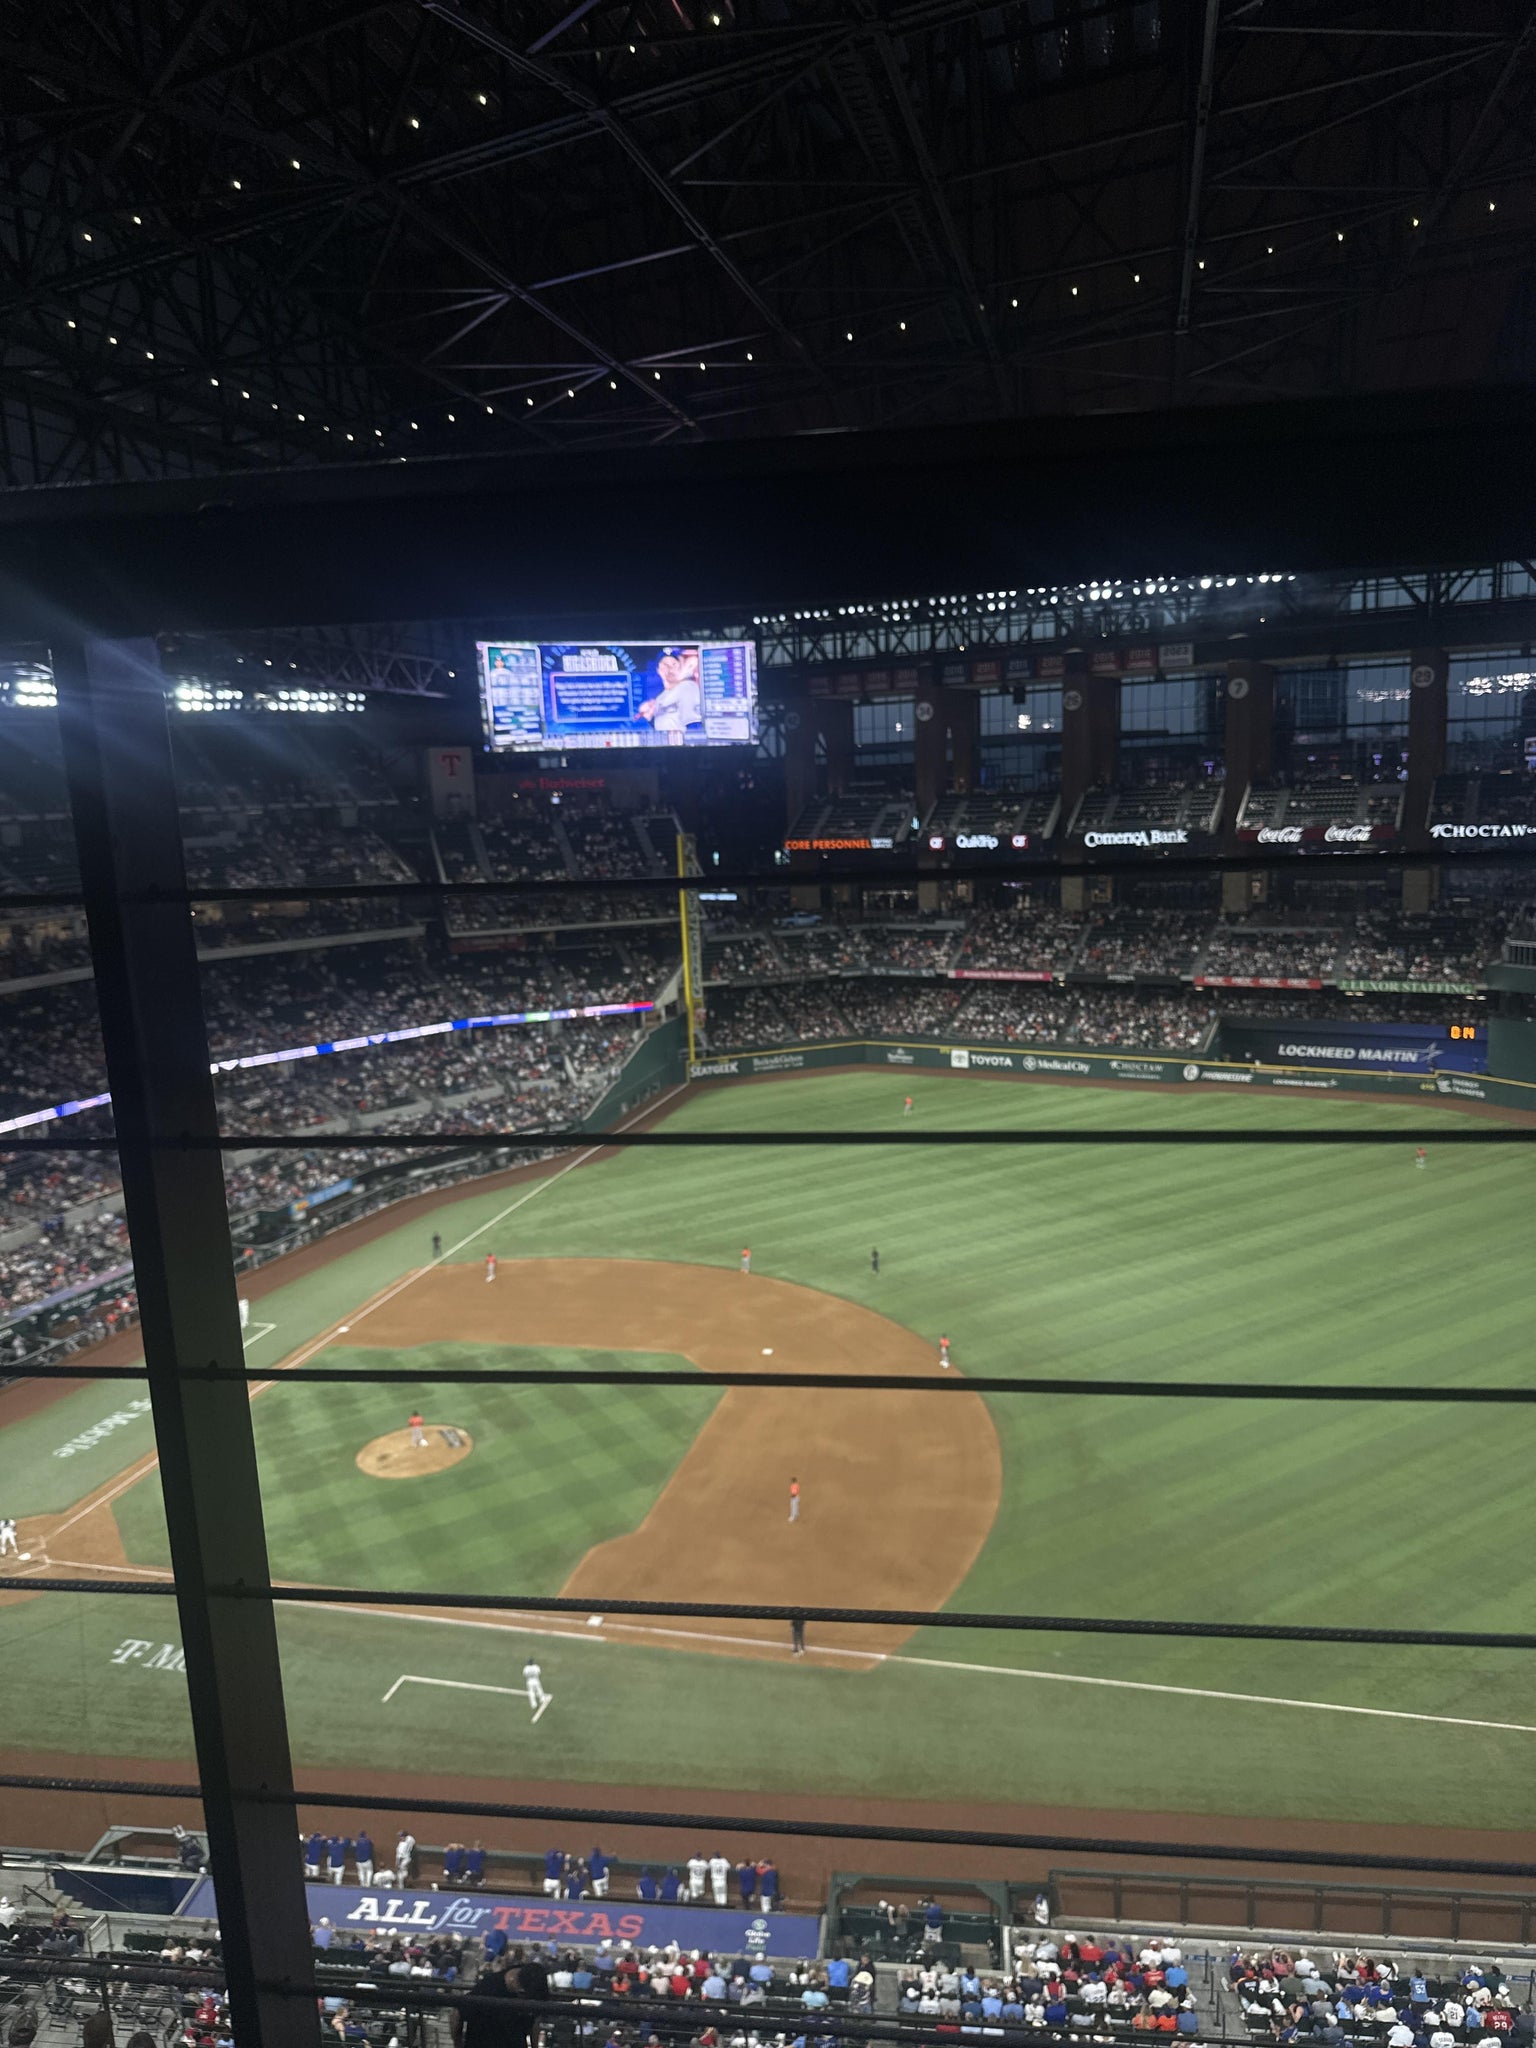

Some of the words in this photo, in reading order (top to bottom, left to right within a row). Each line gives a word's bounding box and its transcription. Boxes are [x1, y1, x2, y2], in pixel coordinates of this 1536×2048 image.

[1150, 829, 1188, 843] Bank
[1257, 826, 1304, 843] Coca-Cola
[1324, 825, 1373, 842] Coca-Cola
[1440, 824, 1527, 837] CHOCTAW
[785, 841, 810, 849] CORE
[813, 840, 871, 849] PERSONNEL
[1278, 1044, 1354, 1059] LOCKHEED
[1358, 1049, 1418, 1063] MARTIN
[971, 1055, 1013, 1067] TOYOTA
[1038, 1060, 1071, 1070] Medical
[1071, 1062, 1090, 1074] City
[347, 1898, 438, 1928] ALL
[426, 1901, 492, 1930] for
[490, 1906, 644, 1938] TEXAS
[1415, 1985, 1426, 1994] 53
[1494, 2021, 1507, 2029] 29
